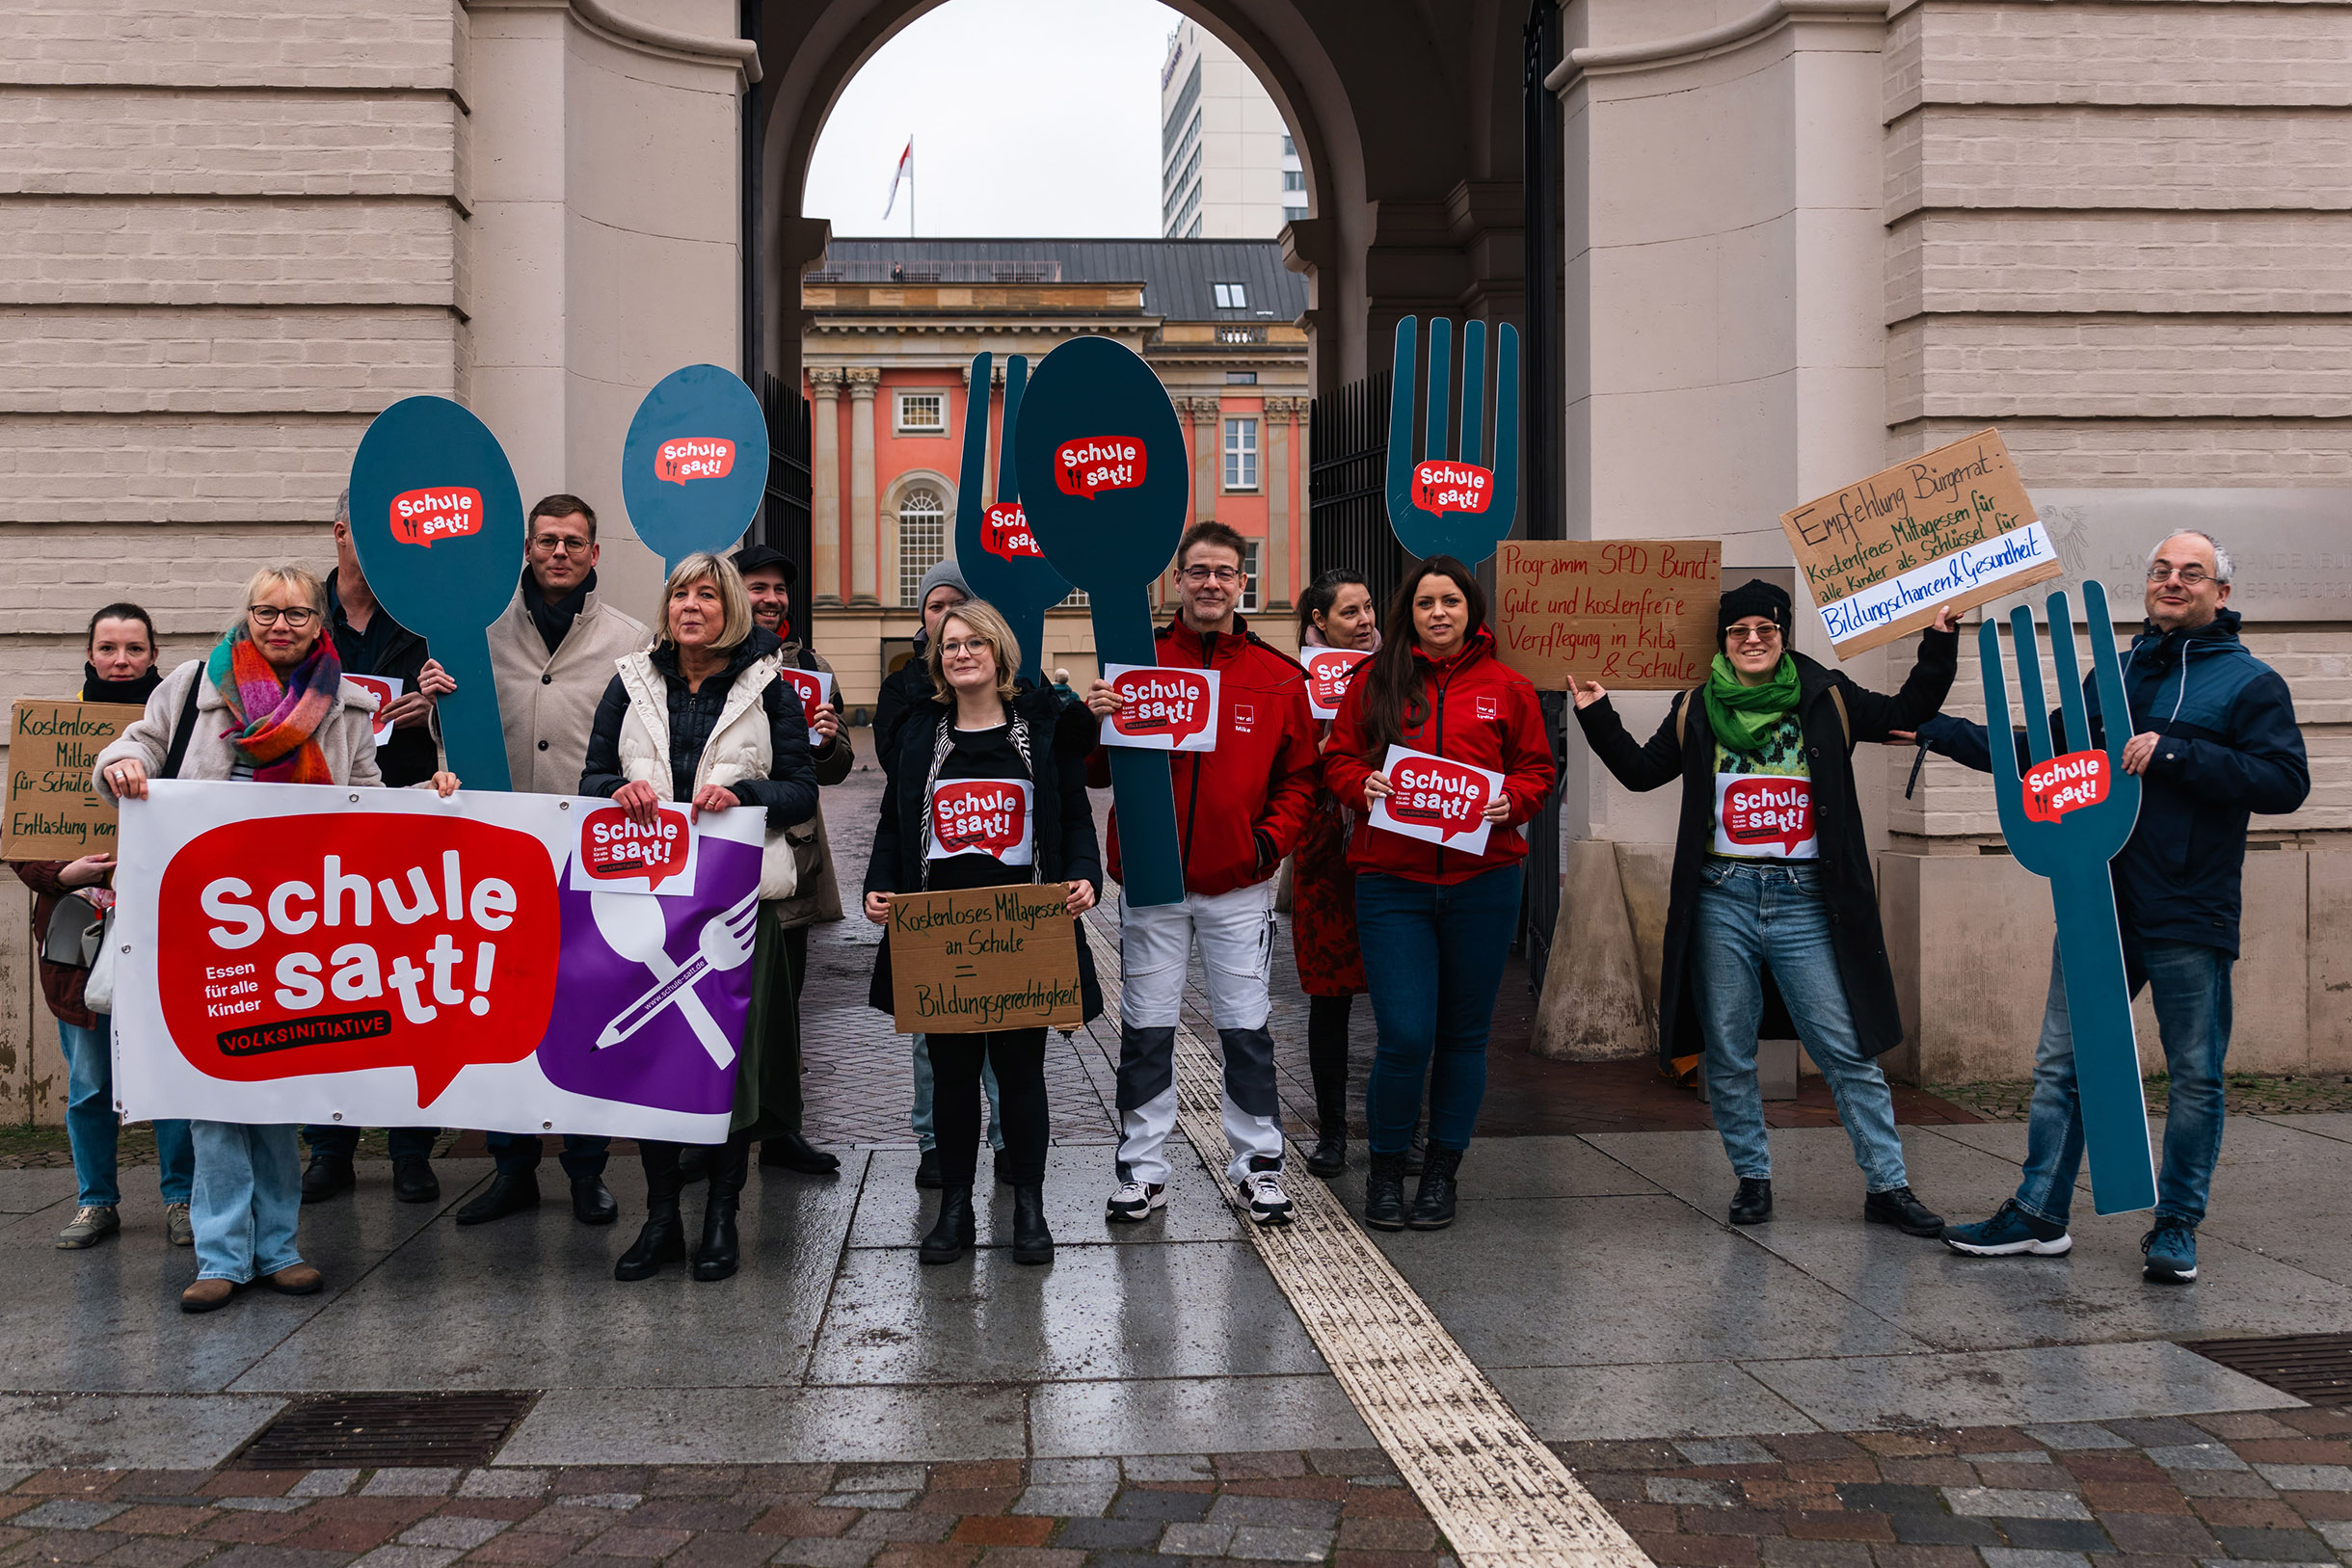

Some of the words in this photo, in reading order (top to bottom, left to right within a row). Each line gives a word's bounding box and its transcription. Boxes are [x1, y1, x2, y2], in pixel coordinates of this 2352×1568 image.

[664, 441, 727, 460] Schule
[1061, 442, 1136, 467] Schule
[681, 460, 722, 475] satt!
[1086, 464, 1133, 486] satt!
[1421, 466, 1484, 489] Schule
[397, 493, 472, 518] Schule
[1438, 490, 1479, 509] satt!
[422, 513, 470, 535] satt!
[991, 509, 1027, 528] Sch
[1793, 482, 1909, 546] Empfehlung
[1008, 533, 1040, 553] sat
[1805, 540, 1893, 585] Kostenfreies
[1890, 508, 1970, 545] Mittagessen
[1970, 490, 1995, 524] für
[1504, 545, 1588, 586] Programm
[1598, 544, 1647, 575] SPD
[1657, 545, 1718, 580] Bund:
[1818, 584, 1843, 603] alle
[1895, 550, 1917, 573] als
[1920, 522, 1988, 561] Schlüssel
[1995, 512, 2020, 535] für
[2109, 554, 2148, 571] LAN
[1548, 586, 1579, 614] und
[1508, 622, 1600, 660] Verpflegung
[1611, 623, 1626, 649] in
[1601, 651, 1620, 678] &
[1627, 651, 1702, 680] Schule
[1121, 678, 1199, 703] Schule
[19, 707, 115, 736] Kostenloses
[1138, 701, 1193, 724] satt!
[13, 771, 37, 801] für
[1401, 769, 1480, 800] Schule
[2029, 758, 2099, 792] Schule
[938, 790, 1016, 819] Schule
[1412, 792, 1471, 820] satt!
[1733, 787, 1809, 811] Schule
[2052, 780, 2097, 809] satt!
[13, 811, 87, 845] Entlastung
[94, 823, 117, 837] von
[592, 817, 678, 843] Schule
[955, 812, 1010, 838] satt!
[1750, 809, 1804, 832] satt!
[611, 840, 671, 865] satt!
[200, 849, 517, 949] Schule
[895, 897, 992, 933] Kostenloses
[995, 892, 1071, 931] Mittagessen
[946, 940, 962, 956] an
[968, 927, 1024, 955] Schule
[205, 962, 255, 979] Essen
[275, 934, 495, 1024] satt!
[204, 984, 228, 999] für
[229, 980, 258, 996] alle
[644, 961, 705, 1010] www.schule-satt.de
[207, 998, 261, 1018] Kinder
[914, 977, 1080, 1024] Bildungsgerechtigkeit
[224, 1017, 385, 1051] VOLKSINITIATIVE
